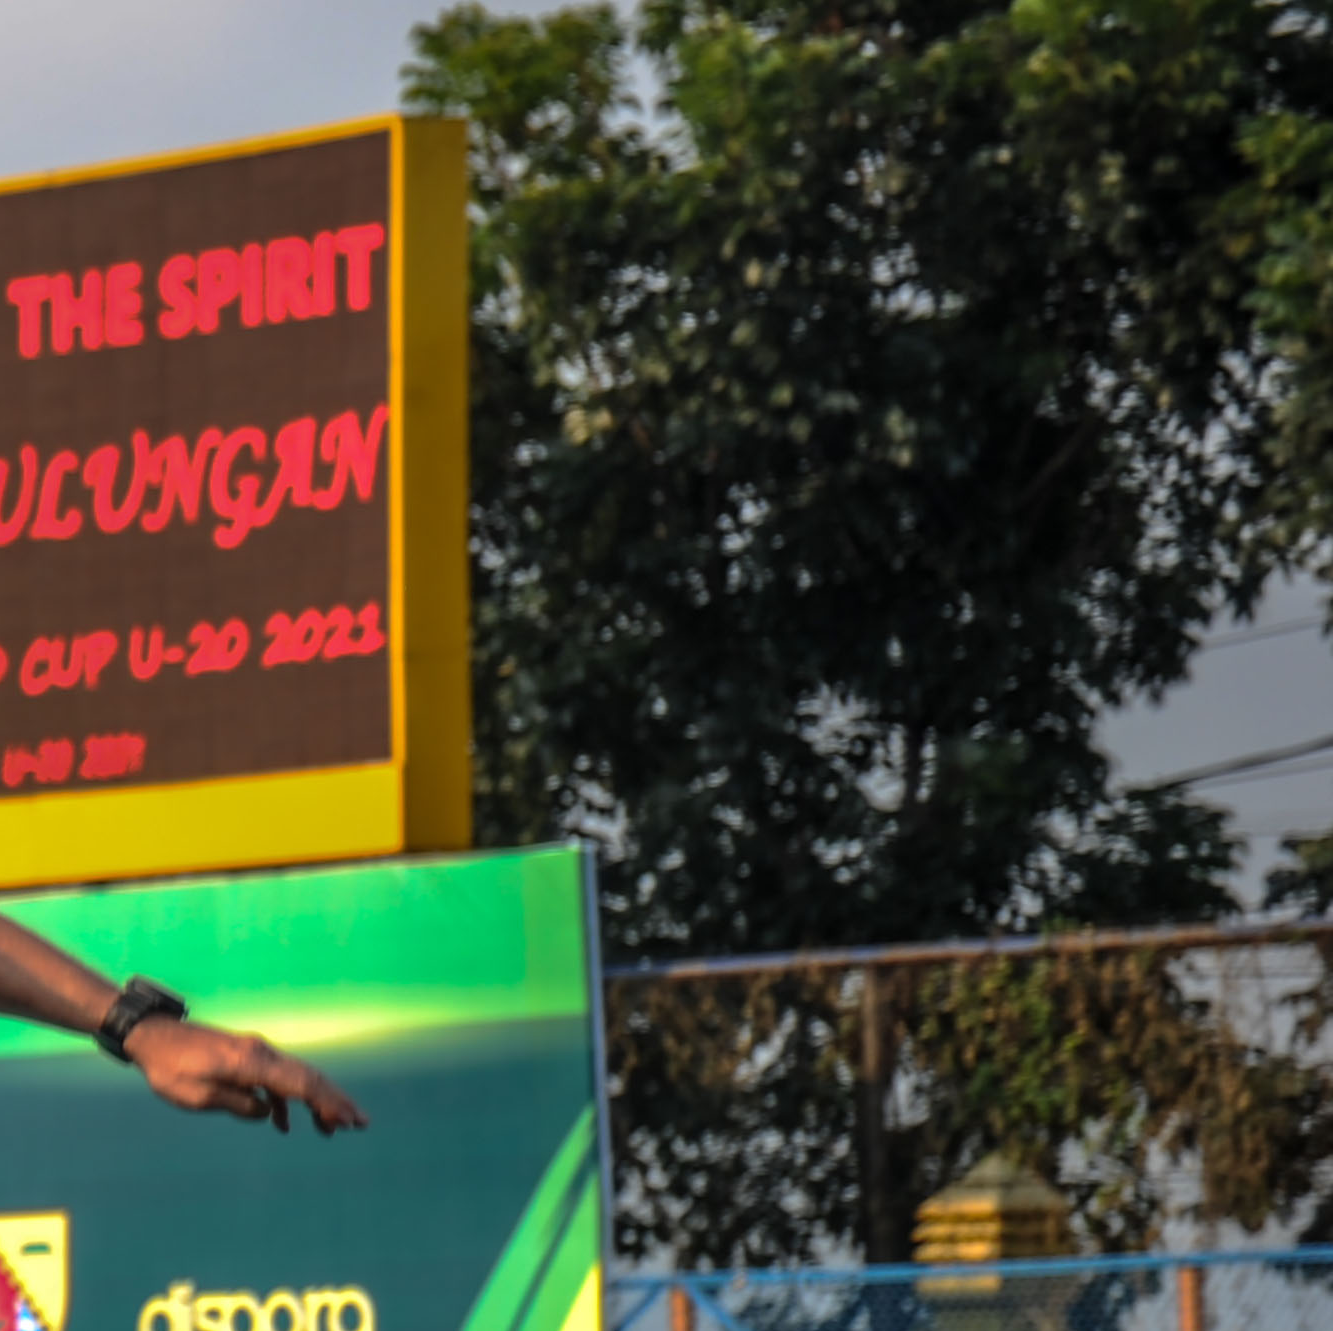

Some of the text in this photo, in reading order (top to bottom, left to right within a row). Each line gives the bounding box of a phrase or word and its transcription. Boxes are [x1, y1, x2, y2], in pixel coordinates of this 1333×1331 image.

[7, 261, 144, 359] THE
[158, 222, 385, 339] SPIRIT
[20, 630, 118, 696] CUP
[129, 618, 250, 680] U-20
